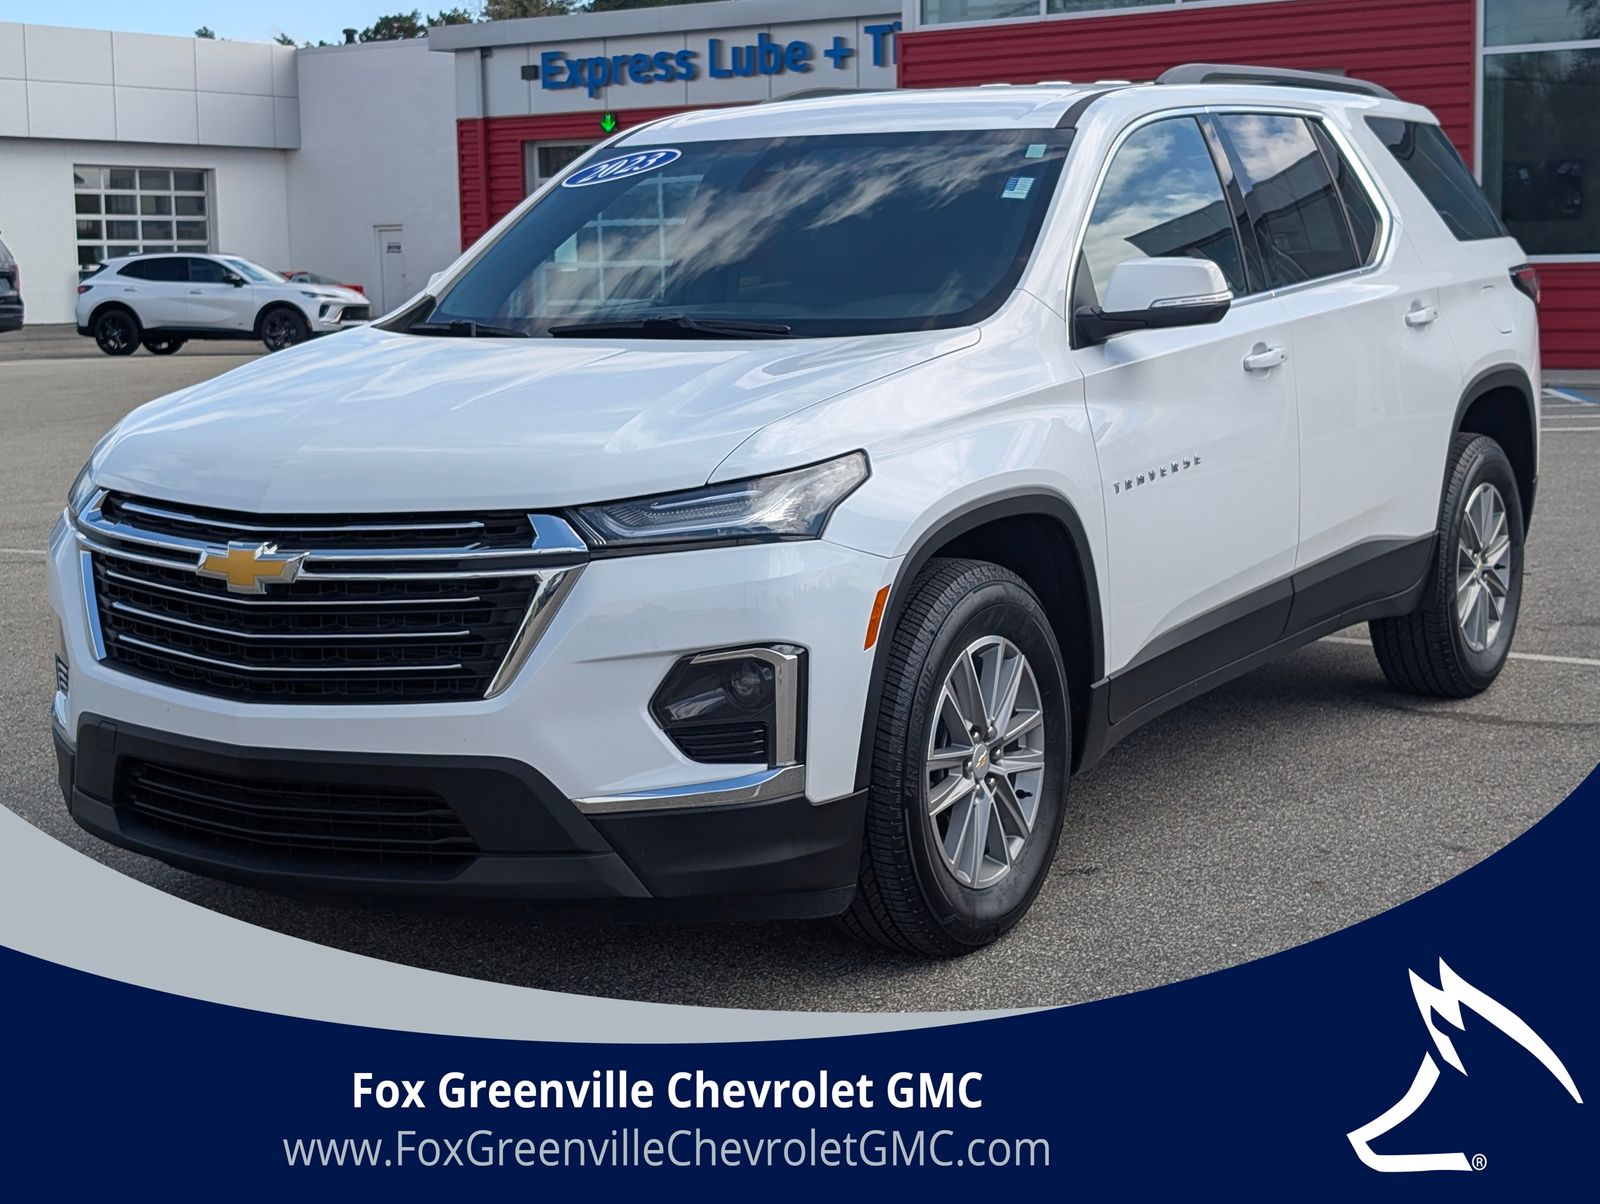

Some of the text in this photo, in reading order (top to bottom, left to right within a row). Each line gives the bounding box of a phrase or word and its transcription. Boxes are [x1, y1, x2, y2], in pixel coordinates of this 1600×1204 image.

[540, 49, 696, 98] Express
[707, 32, 811, 78] Lube
[576, 151, 667, 184] 2023
[1113, 453, 1202, 494] TRAVERSE
